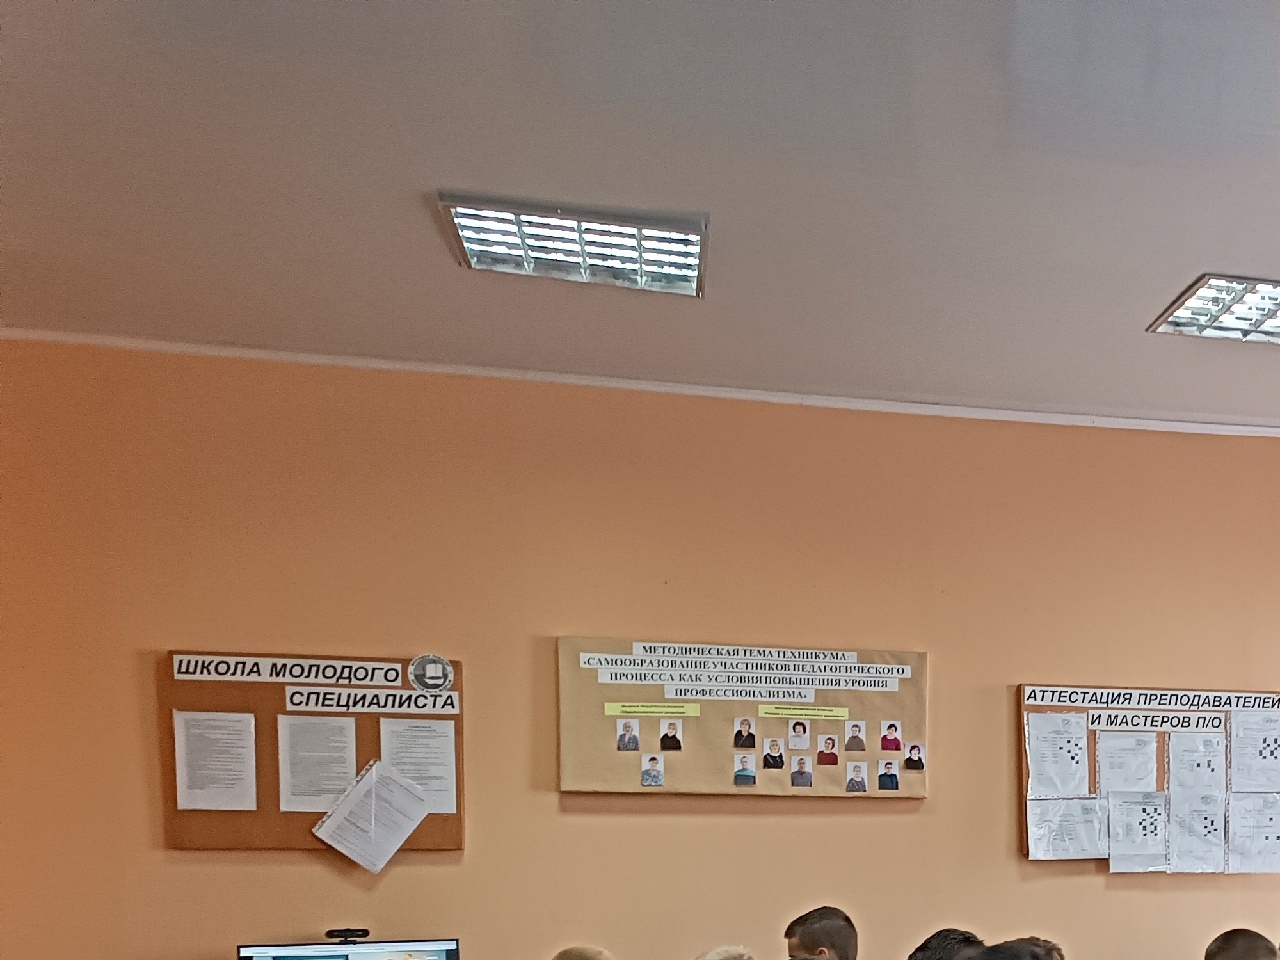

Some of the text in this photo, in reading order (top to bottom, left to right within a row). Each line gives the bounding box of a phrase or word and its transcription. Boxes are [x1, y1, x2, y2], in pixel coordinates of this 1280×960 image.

[642, 645, 739, 658] МЕТОДИЧЕСКАЯ
[742, 648, 773, 659] ТЕМА
[177, 659, 262, 677] ШКОЛА
[269, 663, 400, 684] МОЛОДОГО
[712, 661, 791, 673] УЧАСТНИКОВ
[793, 664, 905, 677] ПЕДАГОГИЧЕСКОГО
[609, 672, 675, 684] ПРОЦЕССА
[678, 673, 702, 683] КАК
[764, 676, 842, 688] ПОВЫШЕНИЯ
[843, 679, 888, 689] УРОВНЯ
[289, 691, 456, 711] СПЕЦИАЛИСТА
[1026, 689, 1132, 708] АТТЕСТАЦИЯ
[1090, 714, 1222, 729] И МАСТЕРОВ П/О
